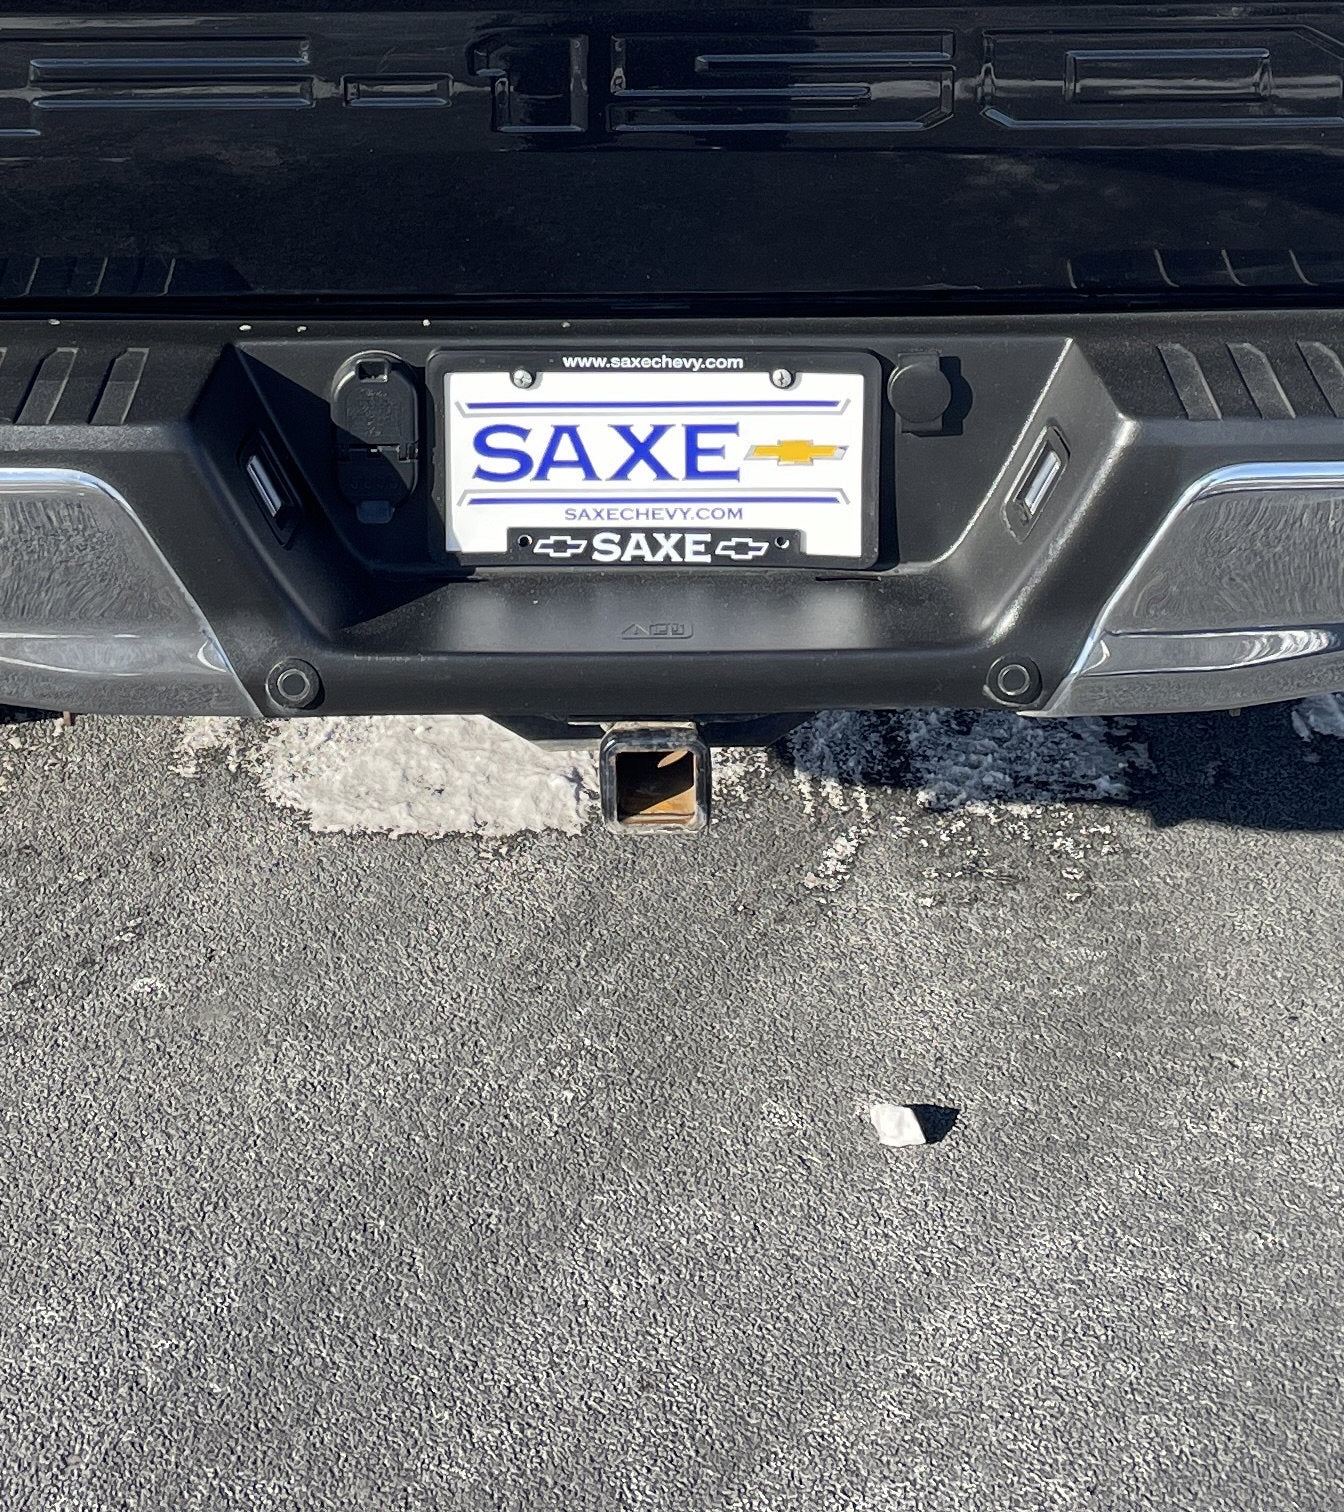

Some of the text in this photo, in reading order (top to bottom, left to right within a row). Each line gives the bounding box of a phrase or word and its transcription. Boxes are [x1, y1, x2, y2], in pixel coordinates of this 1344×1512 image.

[562, 354, 744, 370] www.saxechevy.com
[472, 422, 741, 482] SAXE
[564, 506, 744, 522] SAXECHEVY.COM
[591, 532, 712, 564] SAXE
